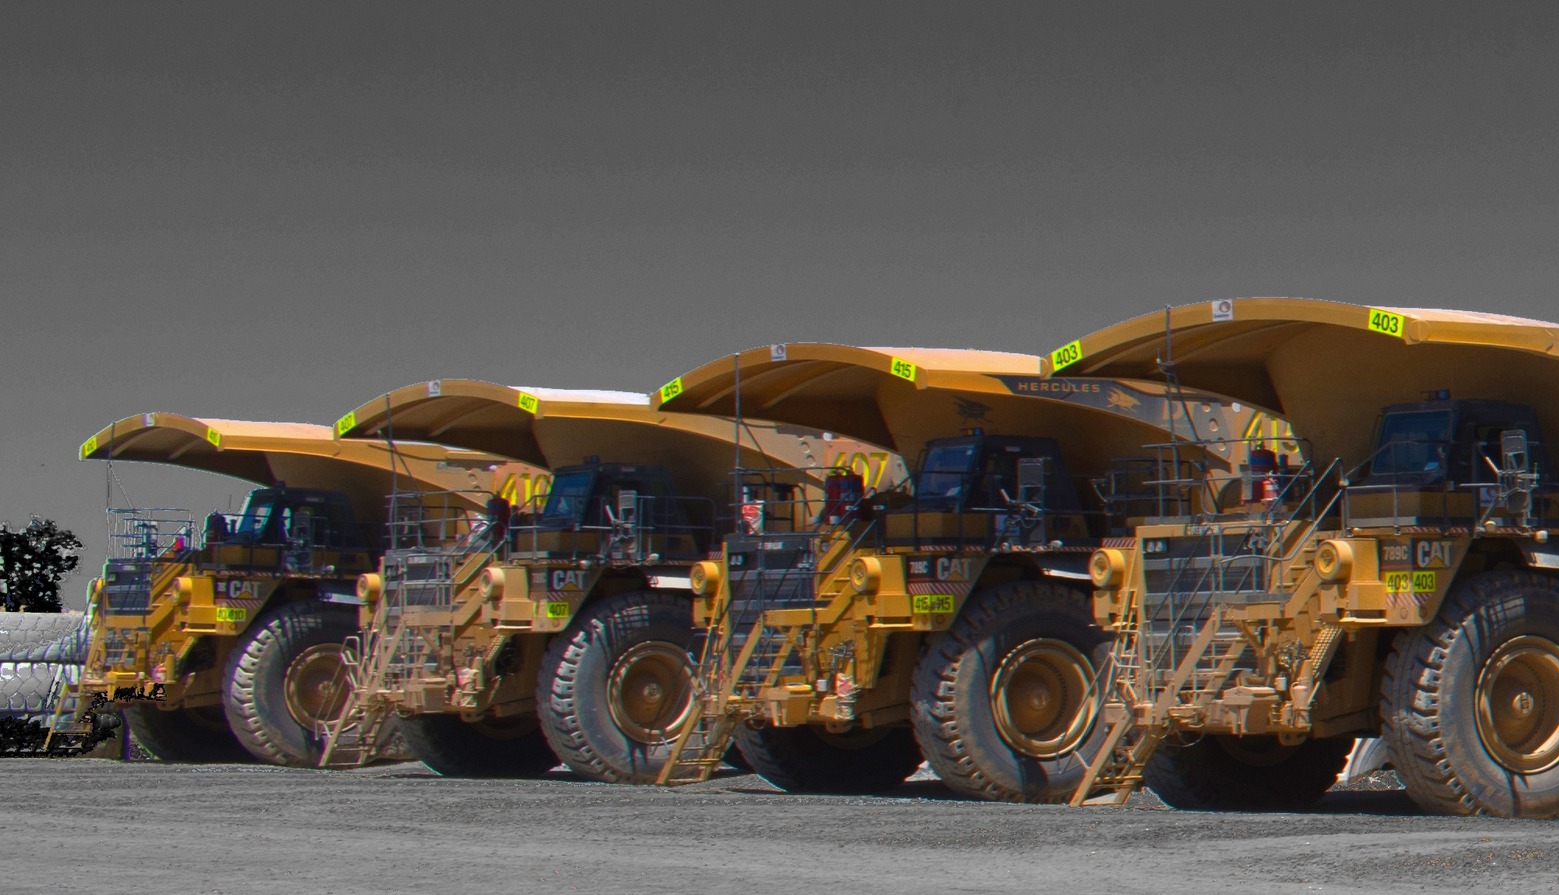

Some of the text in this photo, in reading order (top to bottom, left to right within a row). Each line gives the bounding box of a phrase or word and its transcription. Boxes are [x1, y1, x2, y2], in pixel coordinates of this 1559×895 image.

[1371, 312, 1400, 334] 403
[1055, 344, 1079, 366] 403
[894, 361, 912, 378] 415
[663, 382, 679, 399] 415
[1017, 382, 1101, 393] HERCULES
[520, 395, 536, 411] 407
[1383, 545, 1409, 560] 789C
[1417, 540, 1453, 568] CAT
[936, 557, 973, 581] CAT
[552, 570, 586, 591] CAT
[1387, 574, 1409, 590] 403
[1414, 574, 1434, 590] 403
[229, 580, 263, 599] CAT
[548, 603, 568, 617] 407
